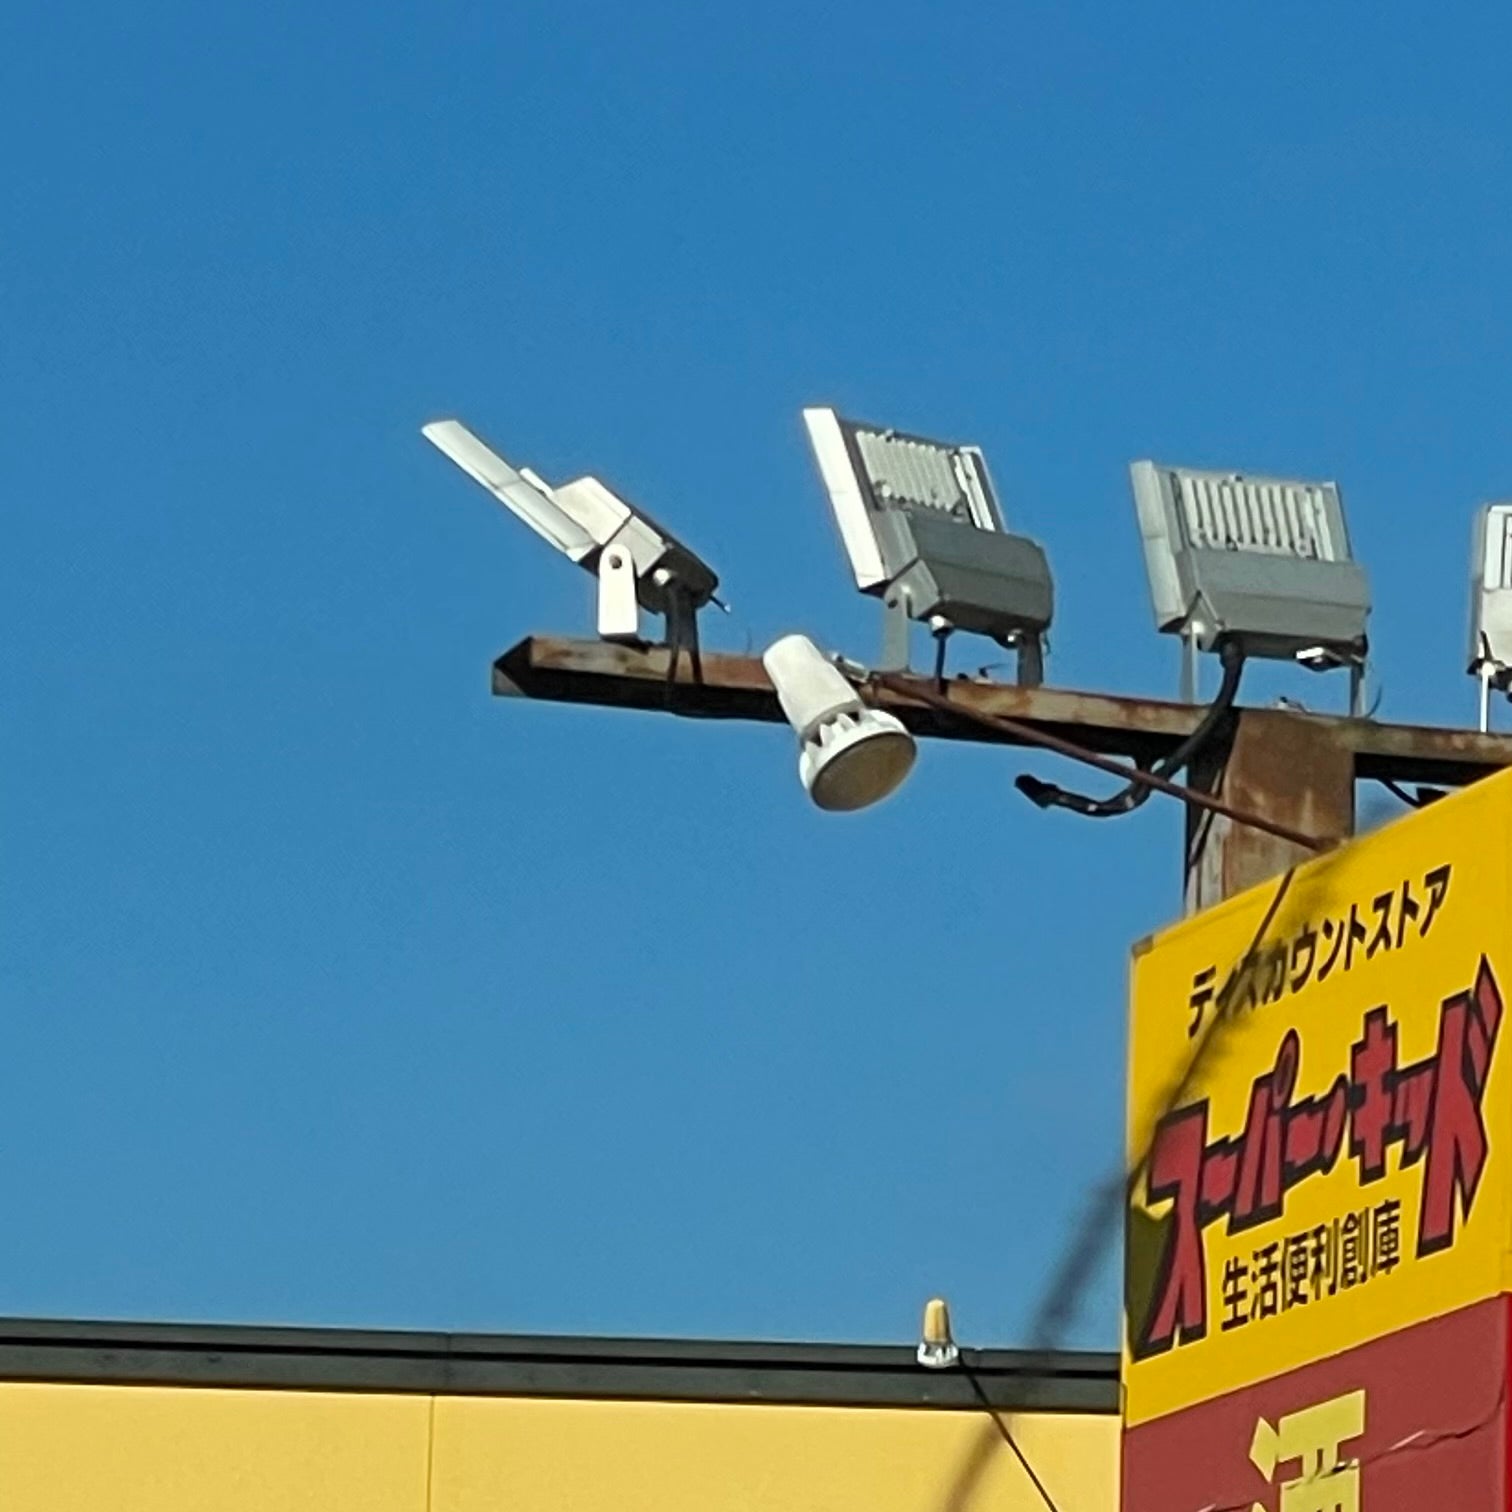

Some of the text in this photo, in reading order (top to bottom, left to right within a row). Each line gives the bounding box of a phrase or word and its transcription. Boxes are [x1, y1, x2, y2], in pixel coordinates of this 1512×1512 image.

[1220, 1199, 1402, 1332] 生活便利創庫
